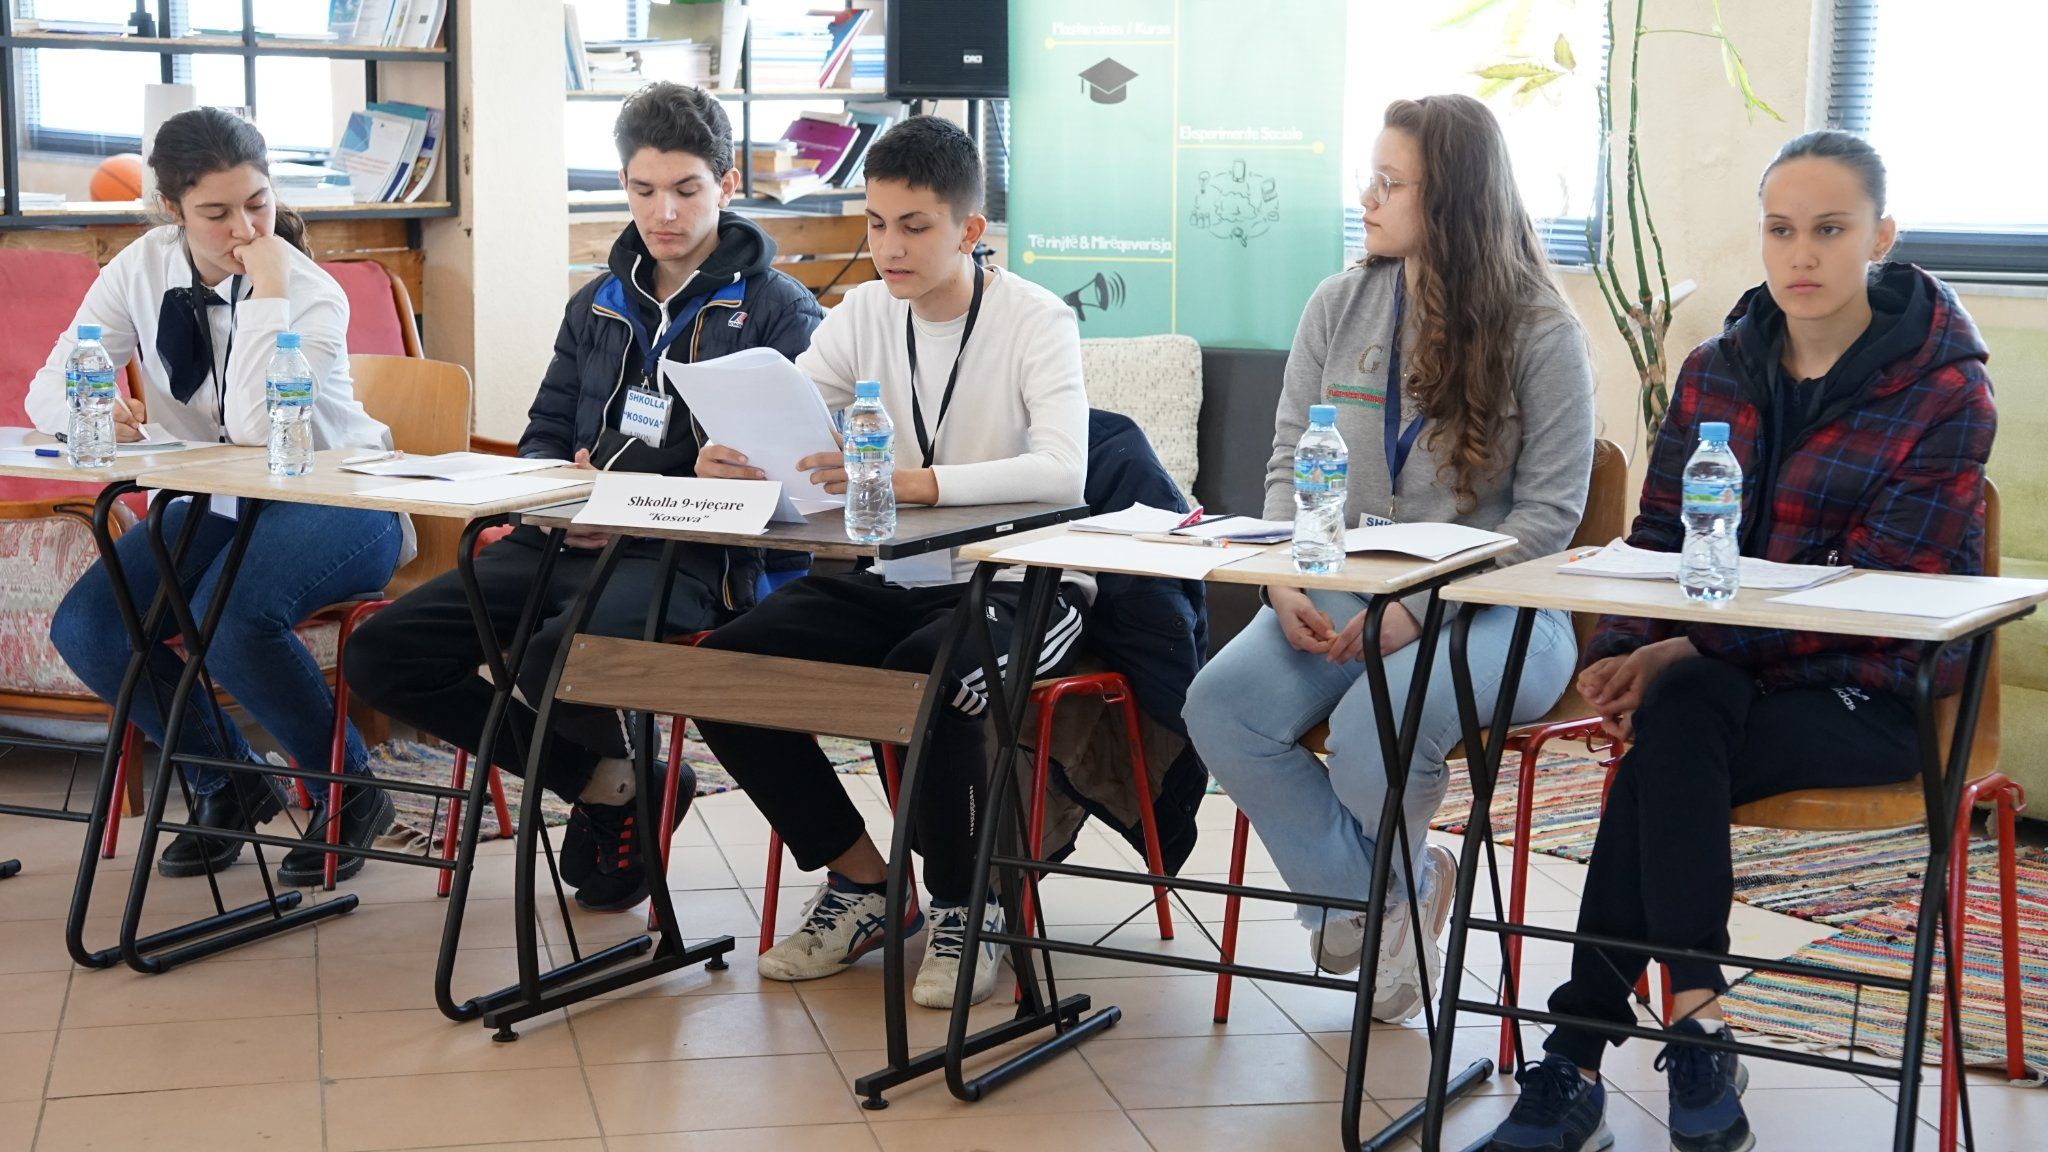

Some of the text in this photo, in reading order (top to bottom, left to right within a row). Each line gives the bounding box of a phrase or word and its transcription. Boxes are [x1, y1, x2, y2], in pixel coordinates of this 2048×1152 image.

[1052, 21, 1124, 35] Masterclass
[1135, 21, 1171, 35] Kurse
[1179, 125, 1303, 142] Eksperimente Sociale
[1079, 235, 1089, 249] &
[629, 392, 665, 410] SHKOLLA
[624, 411, 664, 428] "KOSOVA"
[627, 496, 744, 512] Shkolla 9-vjeçare
[649, 512, 710, 523] "Kosova"
